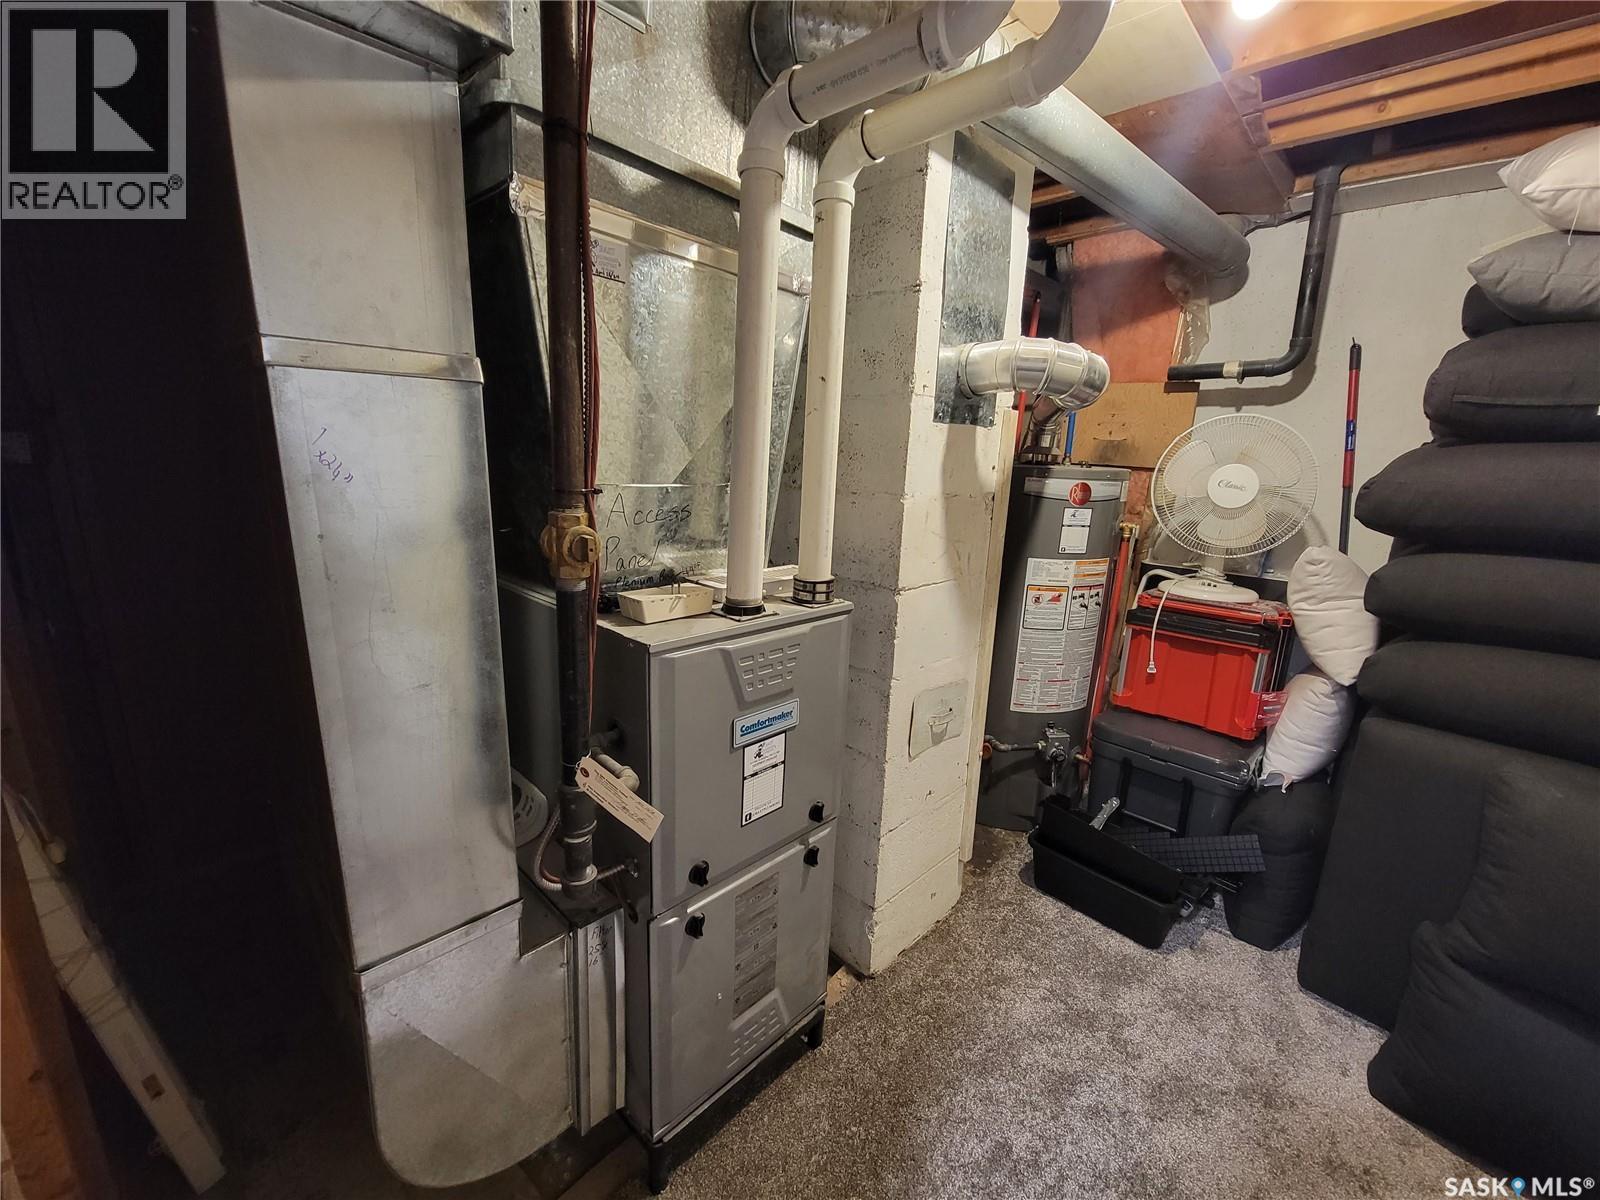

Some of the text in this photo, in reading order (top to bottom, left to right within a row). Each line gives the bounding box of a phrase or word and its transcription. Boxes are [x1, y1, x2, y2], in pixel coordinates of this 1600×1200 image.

[606, 492, 692, 528] Access
[604, 535, 661, 571] Panel
[740, 709, 795, 734] Comfortmaker
